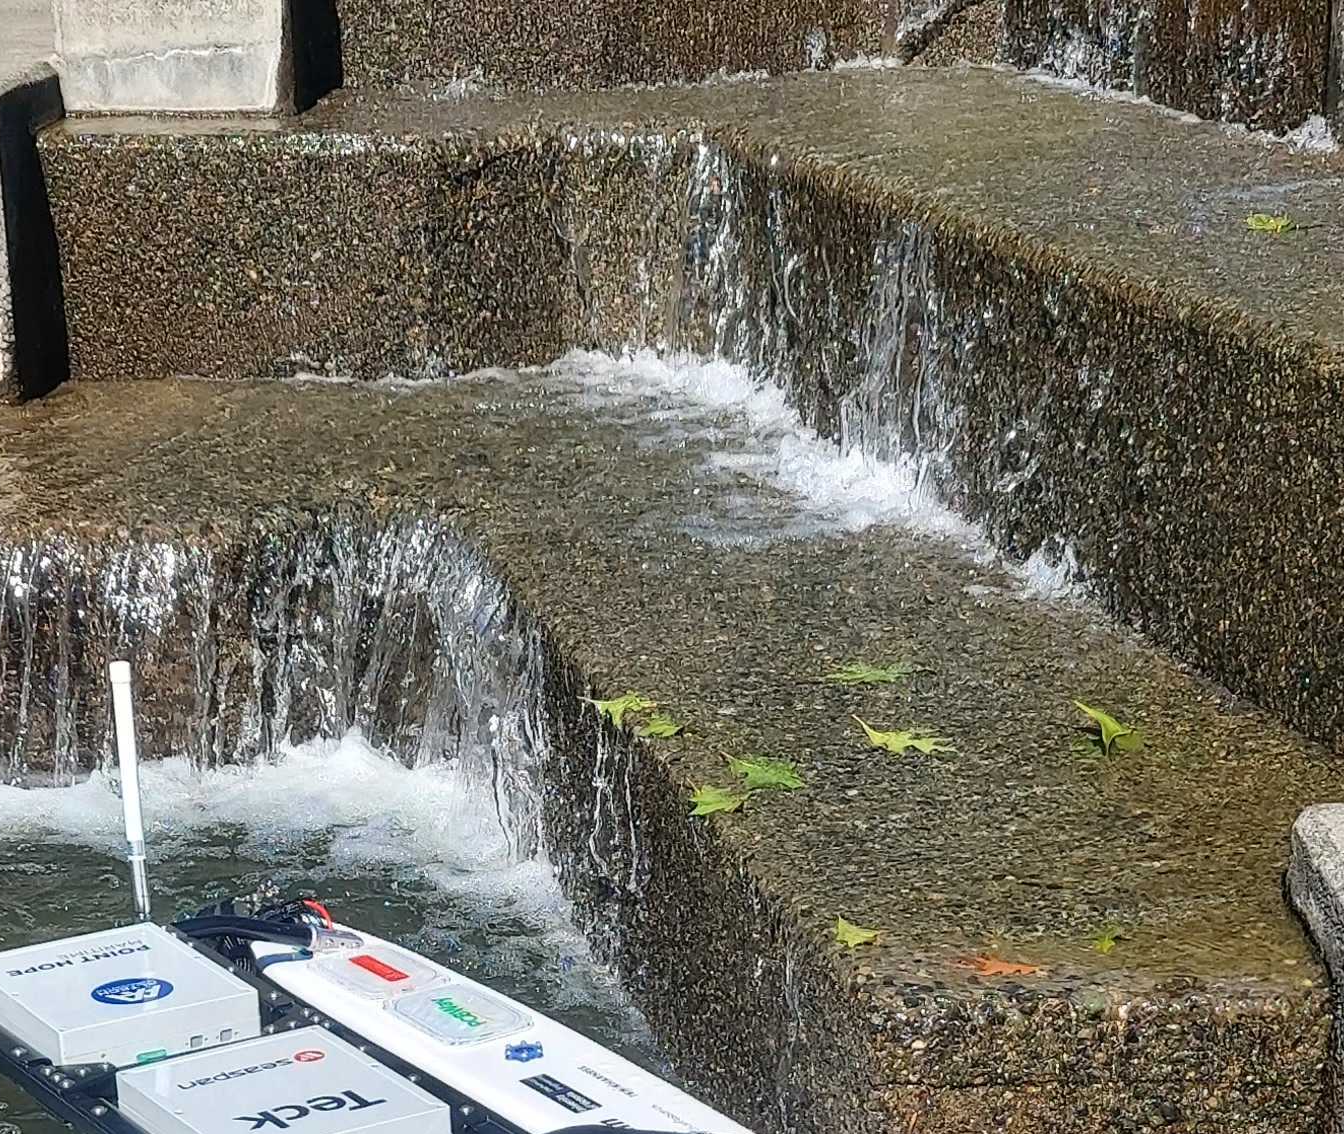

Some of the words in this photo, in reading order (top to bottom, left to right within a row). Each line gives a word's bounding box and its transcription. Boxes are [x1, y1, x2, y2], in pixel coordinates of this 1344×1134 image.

[56, 938, 143, 960] MARITIME
[81, 944, 152, 964] POINT
[5, 959, 75, 977] HOPE
[177, 1057, 294, 1090] seaspan
[232, 1089, 388, 1131] Teck
